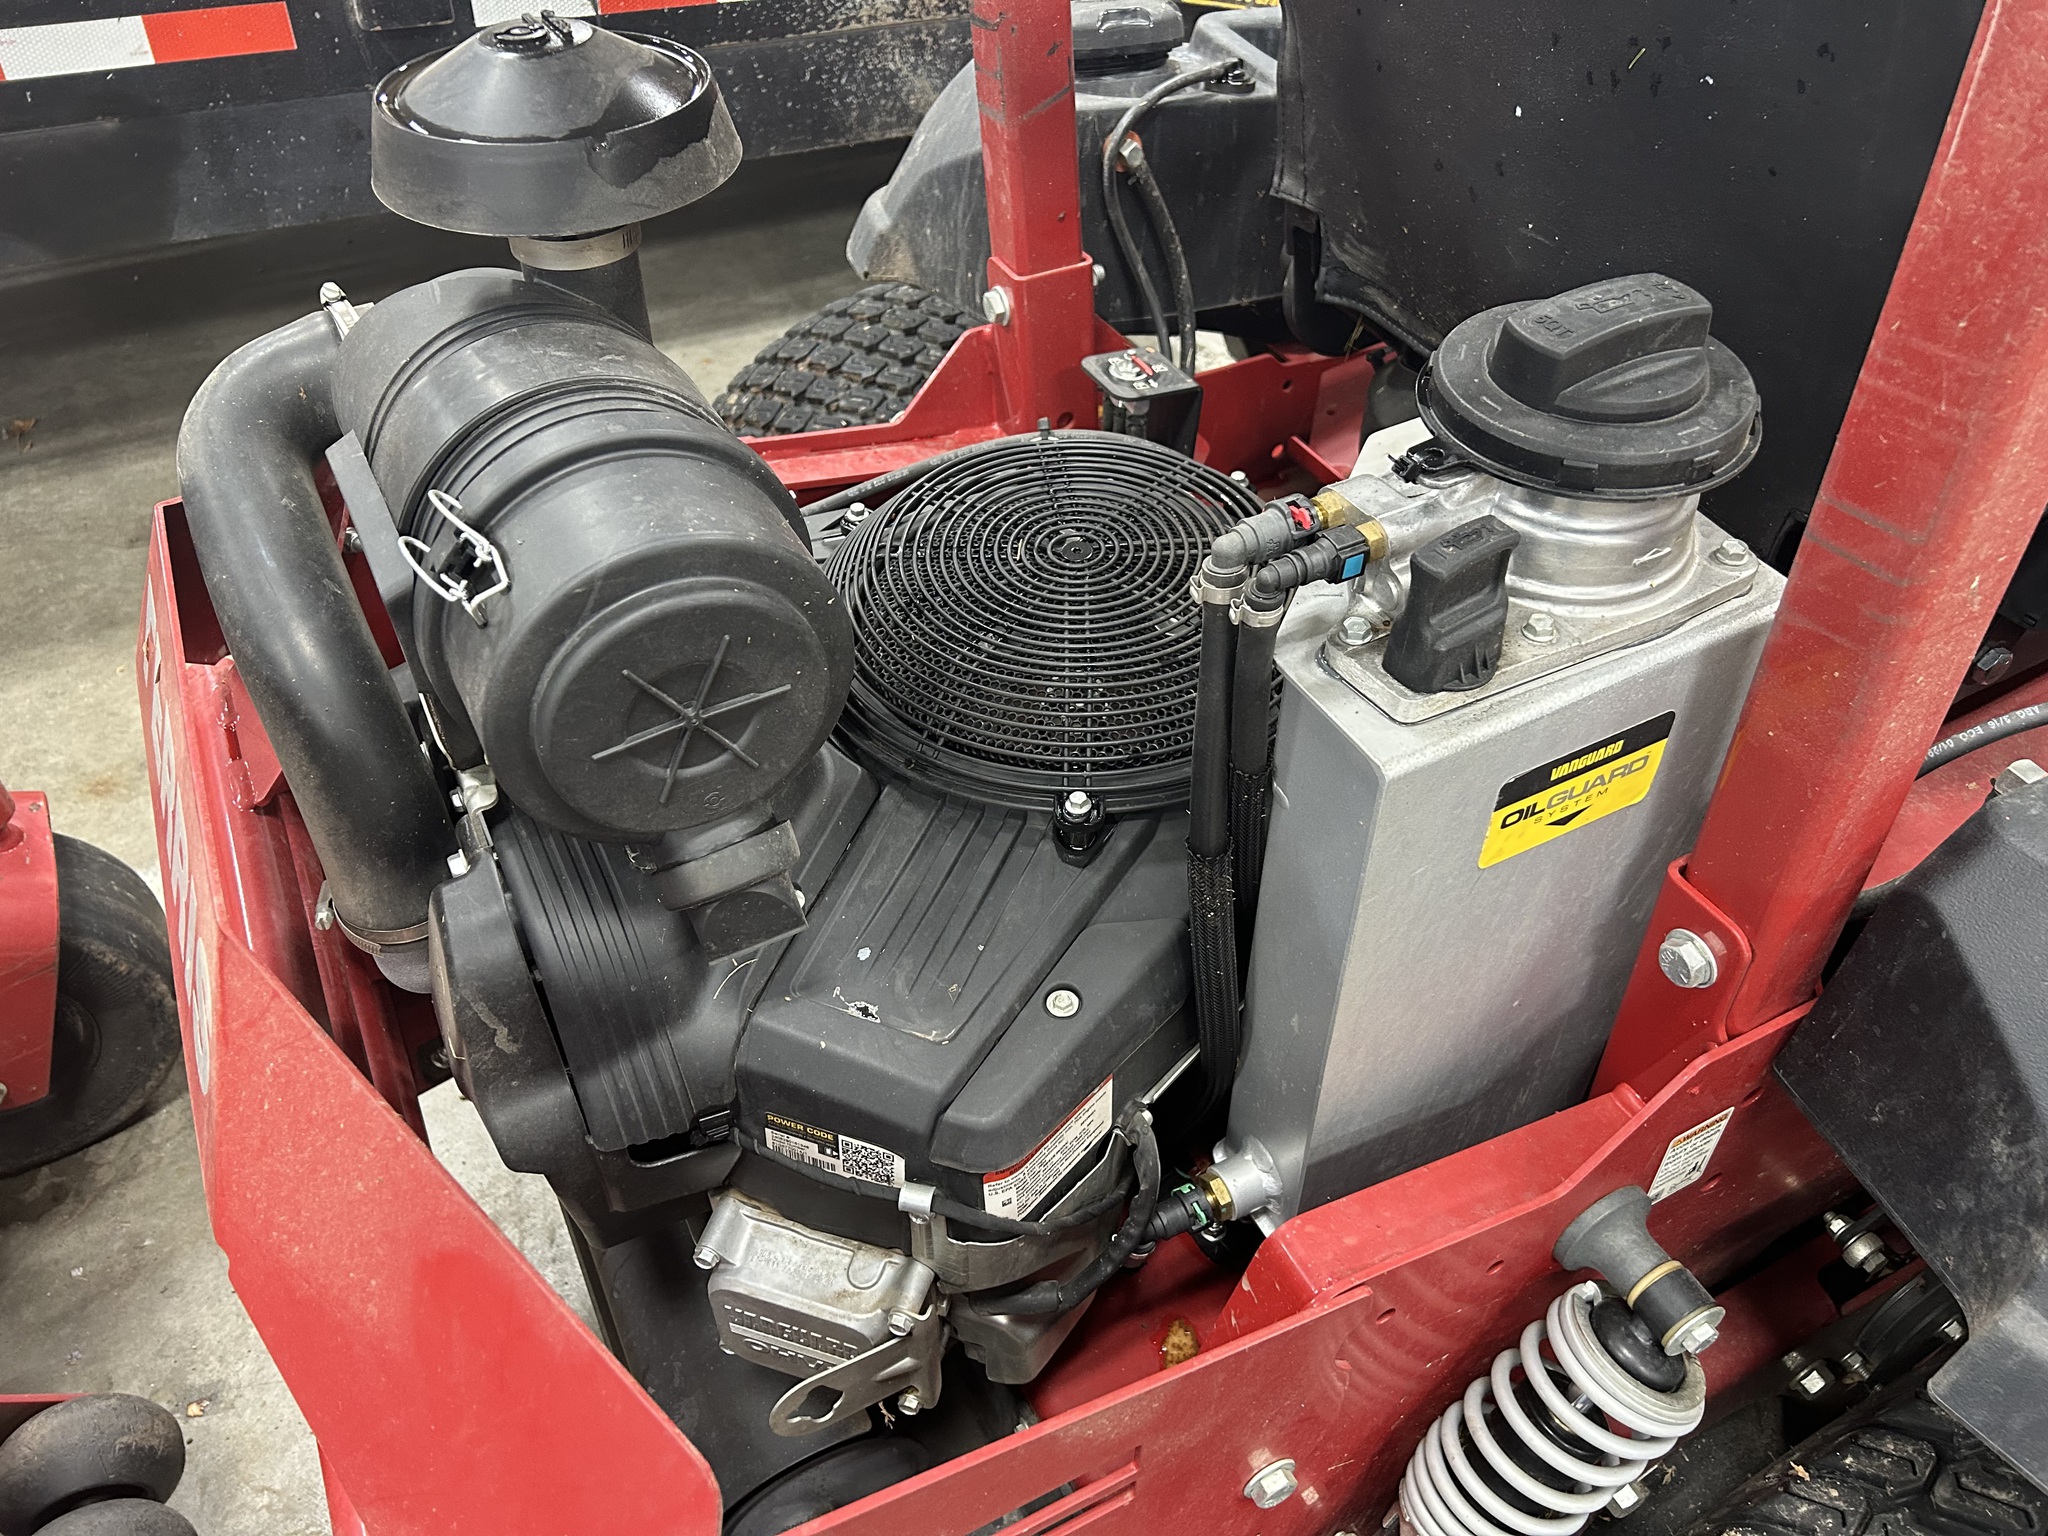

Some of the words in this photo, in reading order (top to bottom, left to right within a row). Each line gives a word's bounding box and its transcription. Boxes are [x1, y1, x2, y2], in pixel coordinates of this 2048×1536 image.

[1959, 725, 1985, 742] ECO
[1987, 716, 2012, 730] 3/16
[1549, 739, 1626, 782] VANGUARD
[1500, 753, 1651, 830] OILGUARD
[1533, 786, 1610, 825] SYSTEM
[142, 574, 213, 1096] FERRIS
[766, 1114, 804, 1131] POWER
[806, 1126, 835, 1142] CODE
